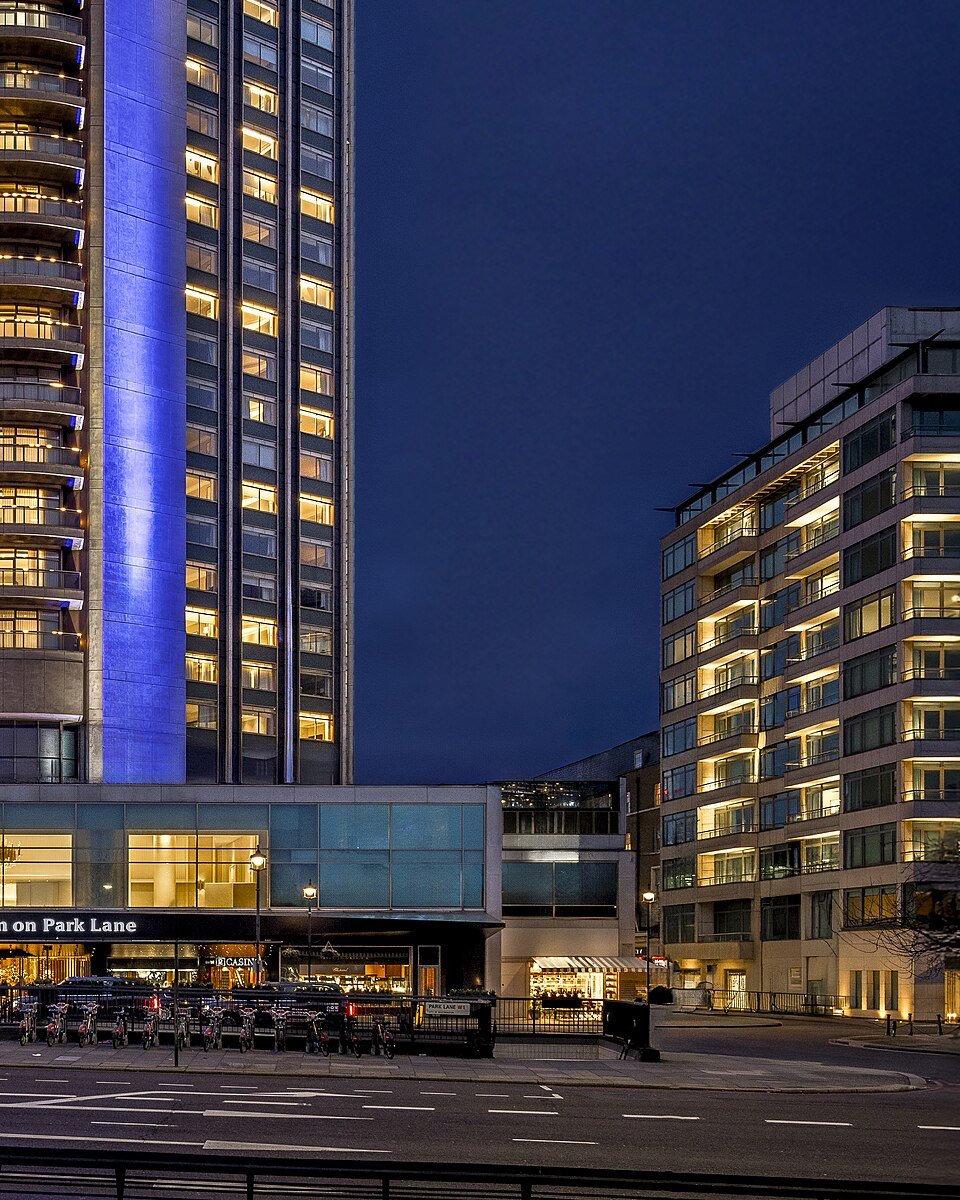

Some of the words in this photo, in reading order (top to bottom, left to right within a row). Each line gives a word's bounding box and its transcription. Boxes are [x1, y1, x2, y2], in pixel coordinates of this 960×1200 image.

[12, 919, 37, 933] on
[42, 917, 86, 933] Park
[90, 917, 137, 933] Lane
[226, 957, 262, 966] CASIN
